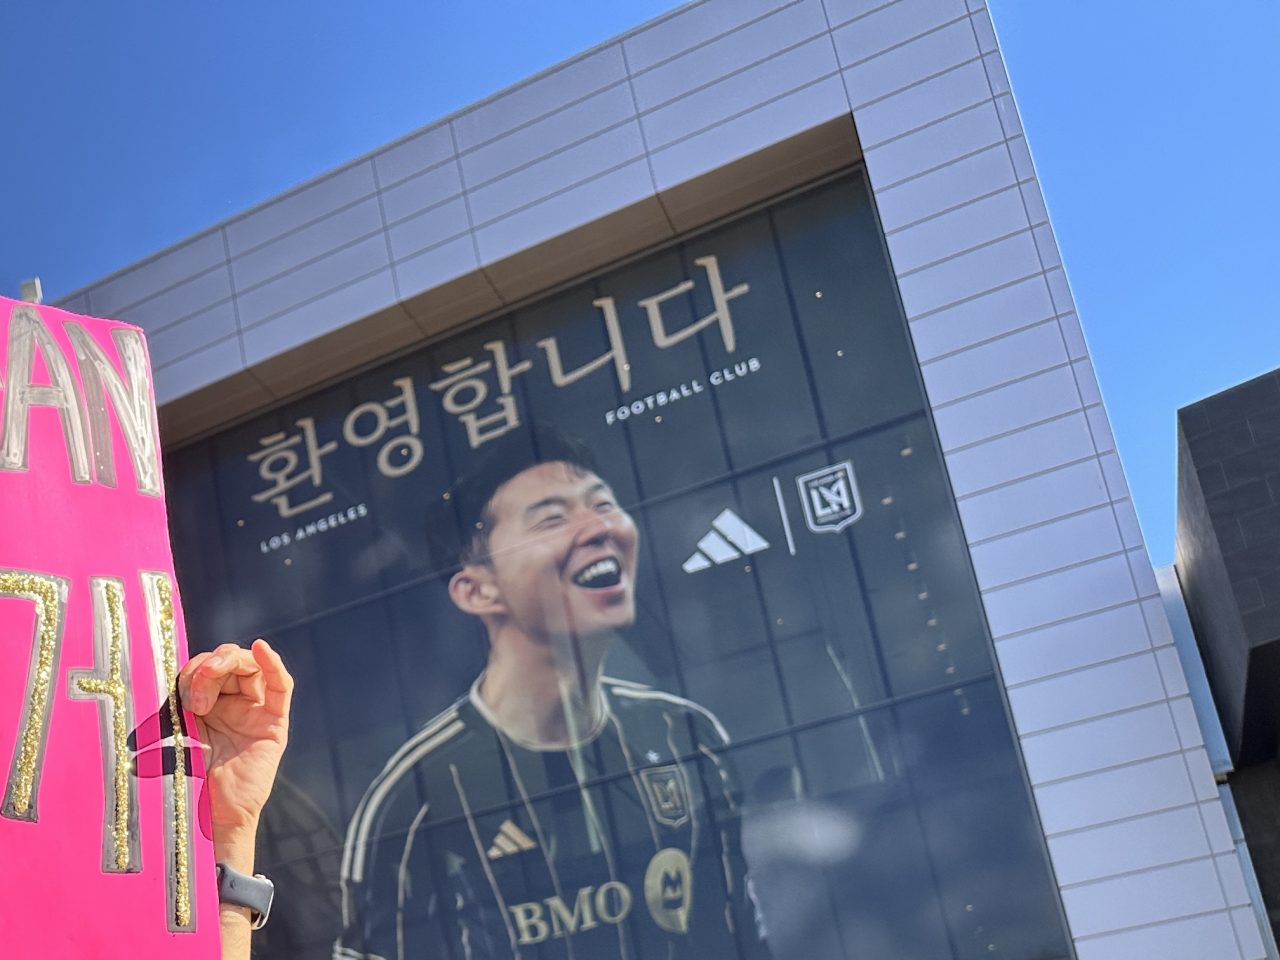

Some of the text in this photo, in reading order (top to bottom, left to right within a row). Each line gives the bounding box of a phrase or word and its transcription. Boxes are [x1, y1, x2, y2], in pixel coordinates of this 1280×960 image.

[246, 255, 749, 519] 환영합니다
[605, 357, 762, 426] FOOTBALL CLUB
[260, 503, 368, 554] LOS ANGELES
[509, 881, 632, 945] BMO
